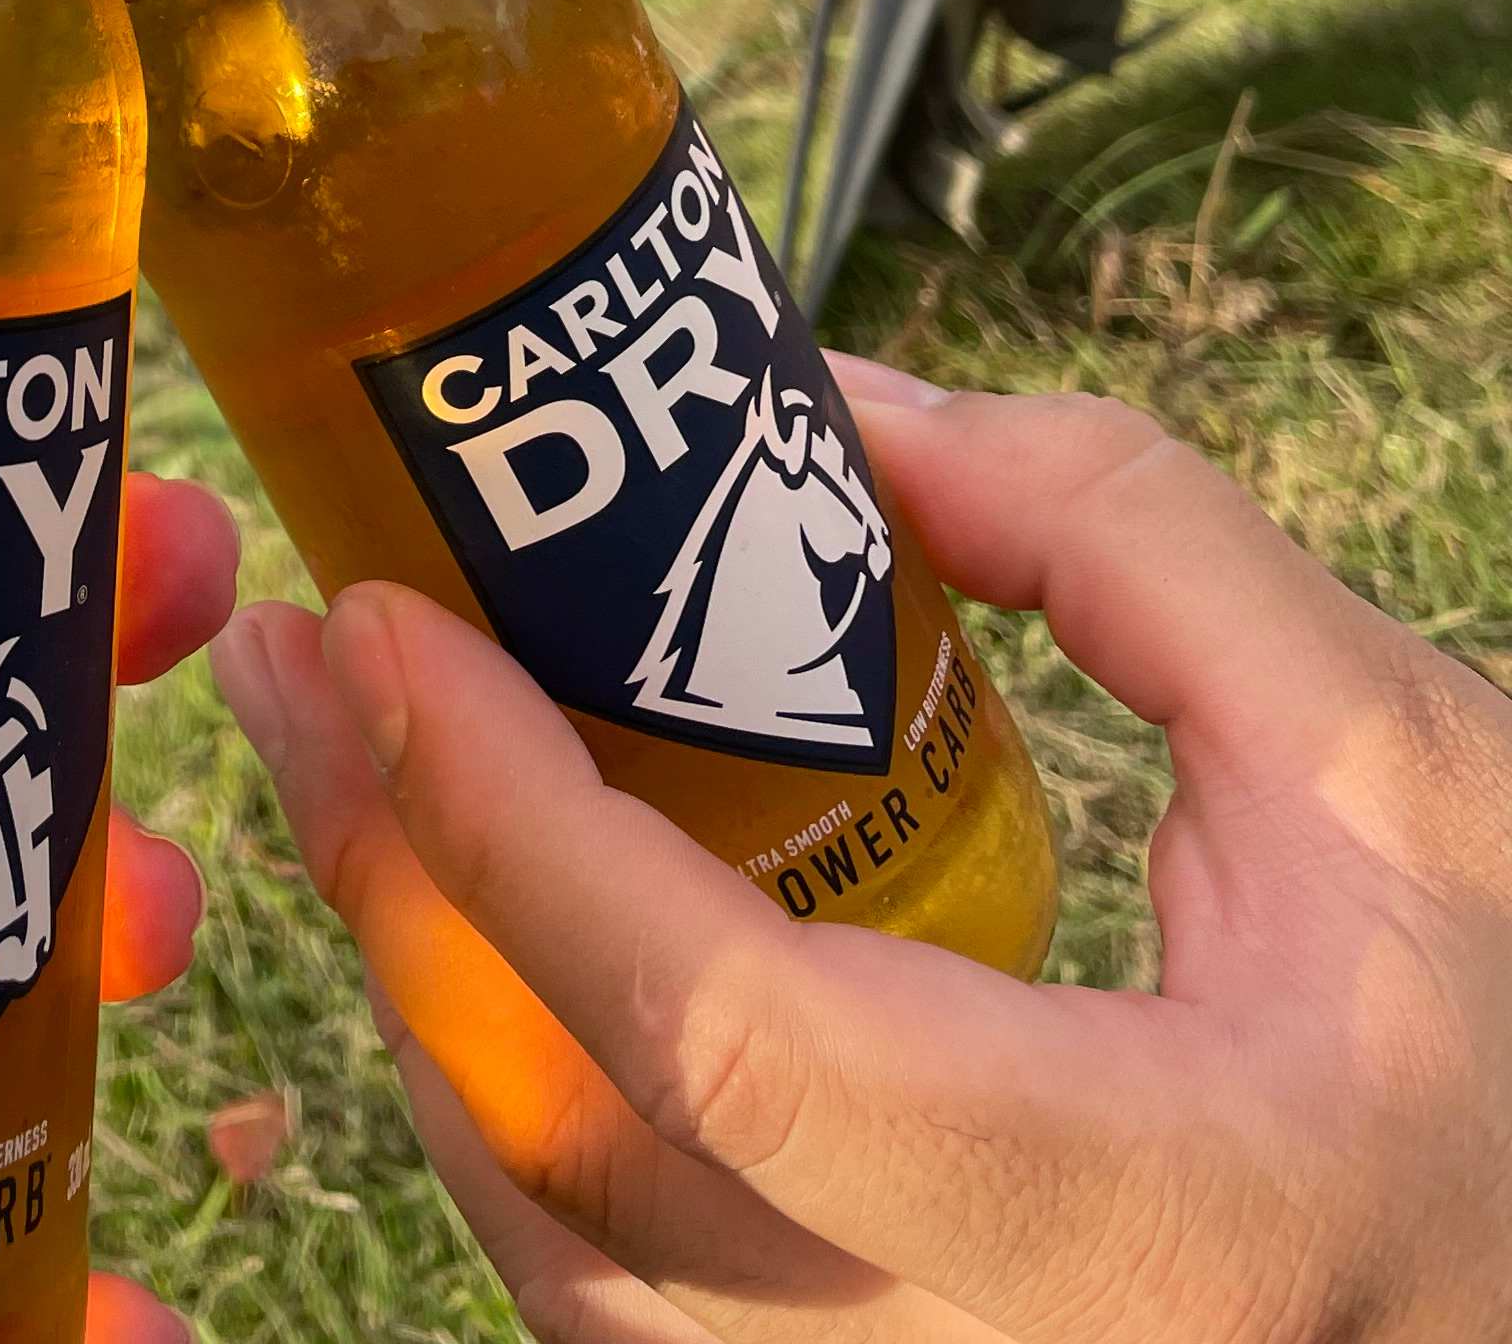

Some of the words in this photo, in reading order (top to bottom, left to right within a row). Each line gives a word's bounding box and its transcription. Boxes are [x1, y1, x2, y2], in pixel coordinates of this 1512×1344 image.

[422, 120, 723, 424] CARLTON
[446, 186, 779, 551] DRY
[737, 847, 785, 880] LTRA
[784, 800, 852, 857] SMOOTH
[777, 787, 920, 917] OWER
[921, 656, 976, 794] CARB
[904, 710, 928, 751] LOW
